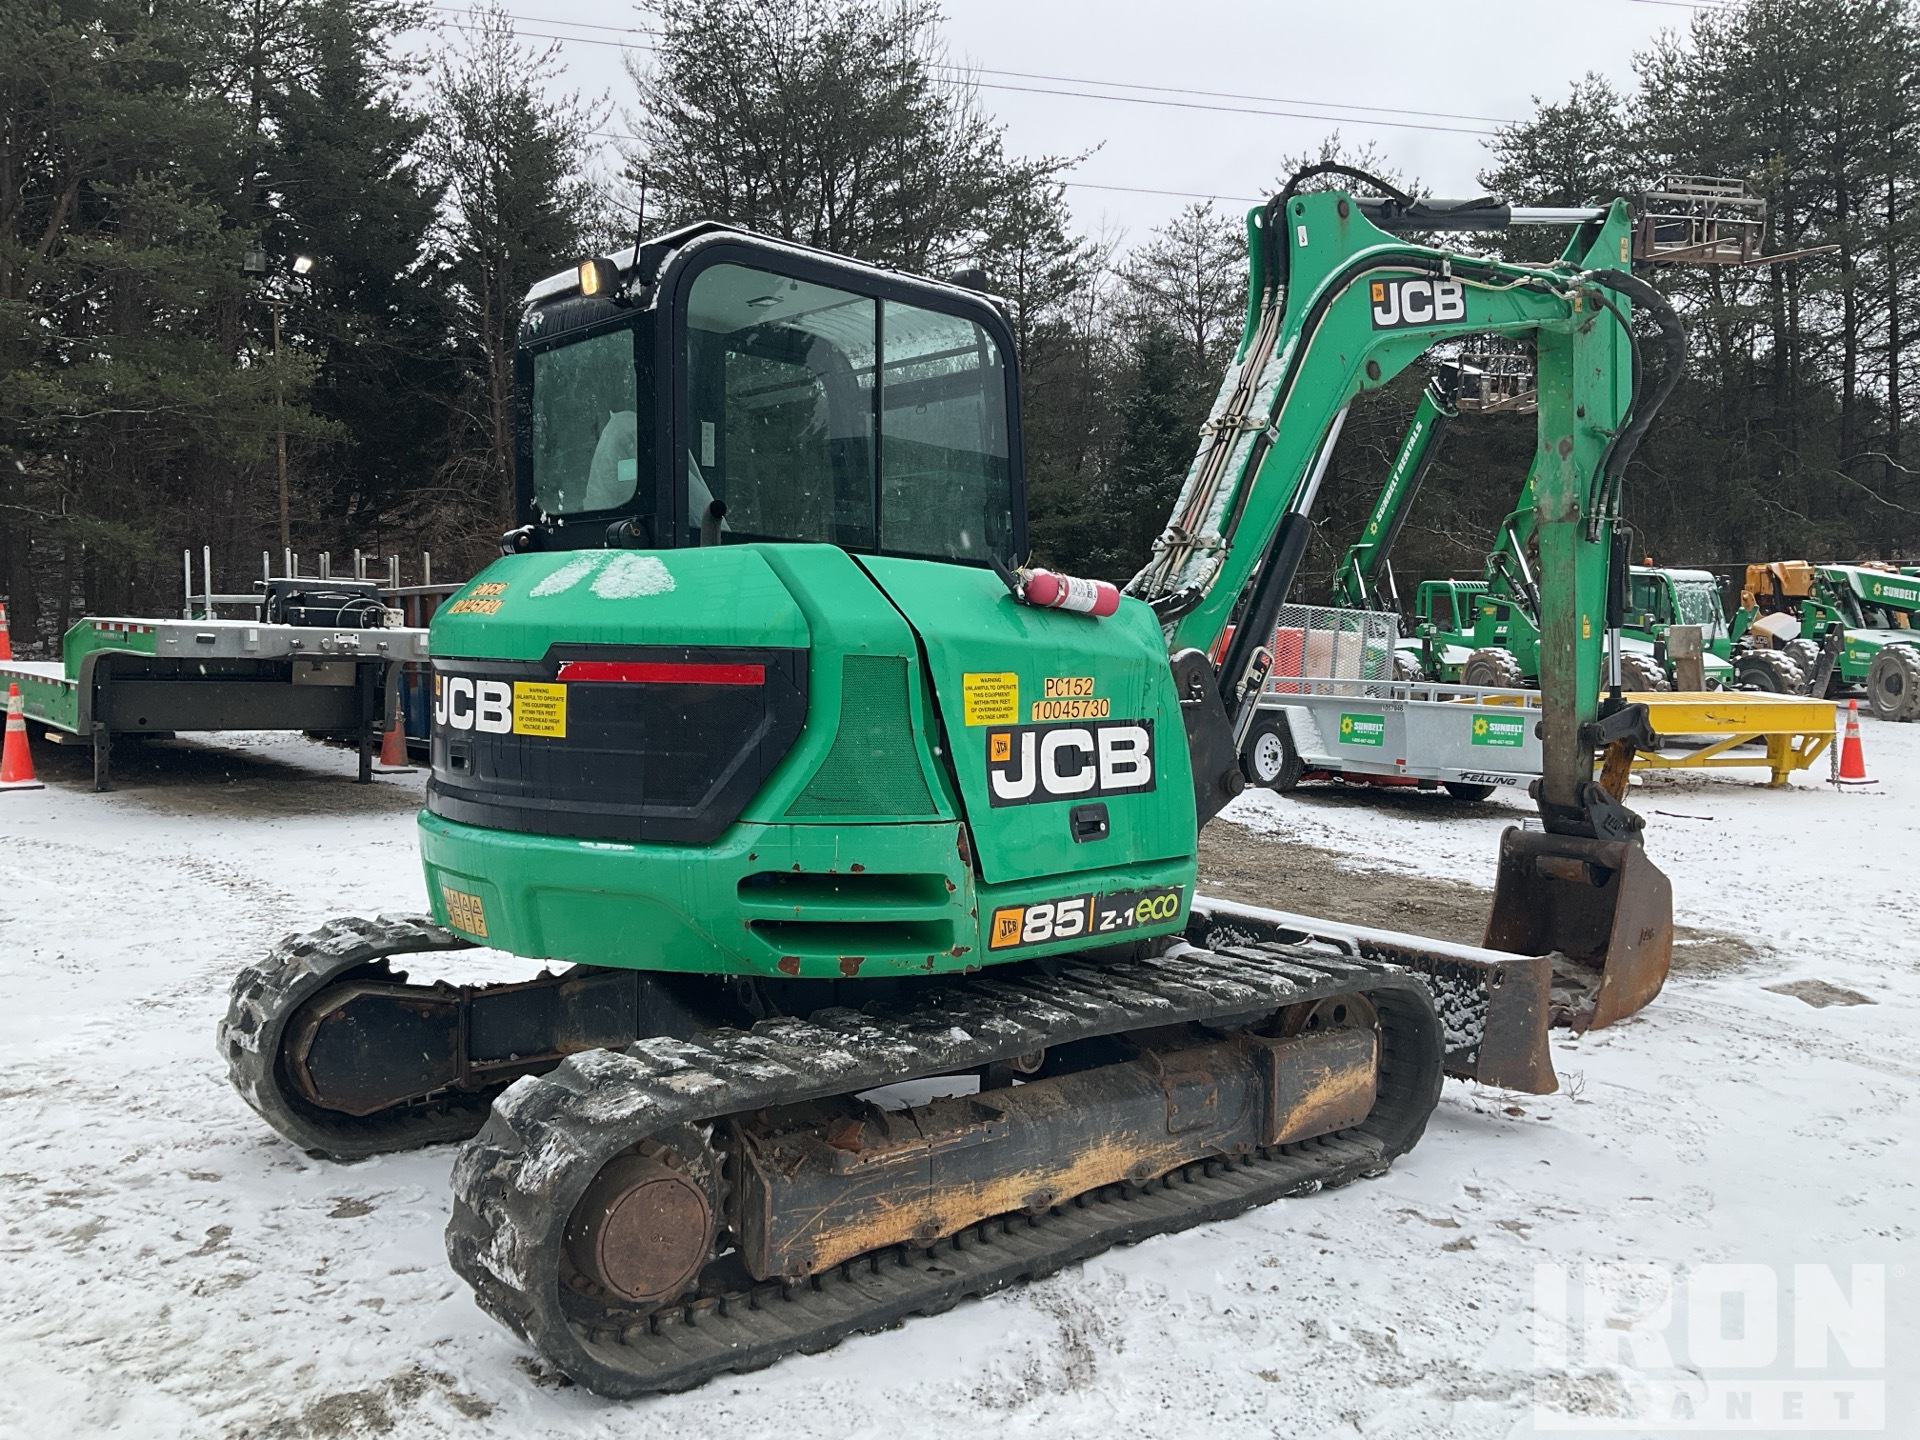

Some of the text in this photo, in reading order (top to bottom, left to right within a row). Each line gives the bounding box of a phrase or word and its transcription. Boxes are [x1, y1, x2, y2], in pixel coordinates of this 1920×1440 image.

[1374, 281, 1464, 325] JCB
[1376, 421, 1422, 522] SUNBELT RENTALS
[1883, 586, 1917, 601] SUNBELT
[1046, 678, 1093, 696] PC152
[436, 676, 512, 734] JCB
[1034, 699, 1109, 719] 10045730
[1354, 722, 1383, 731] SUNBELT
[1489, 723, 1523, 732] SUNBELT
[996, 741, 1007, 754] JCB
[992, 727, 1151, 799] JCB
[1458, 772, 1517, 785] FELLING
[1022, 893, 1178, 942] 85 Z-1 eco
[1001, 918, 1017, 939] JCB
